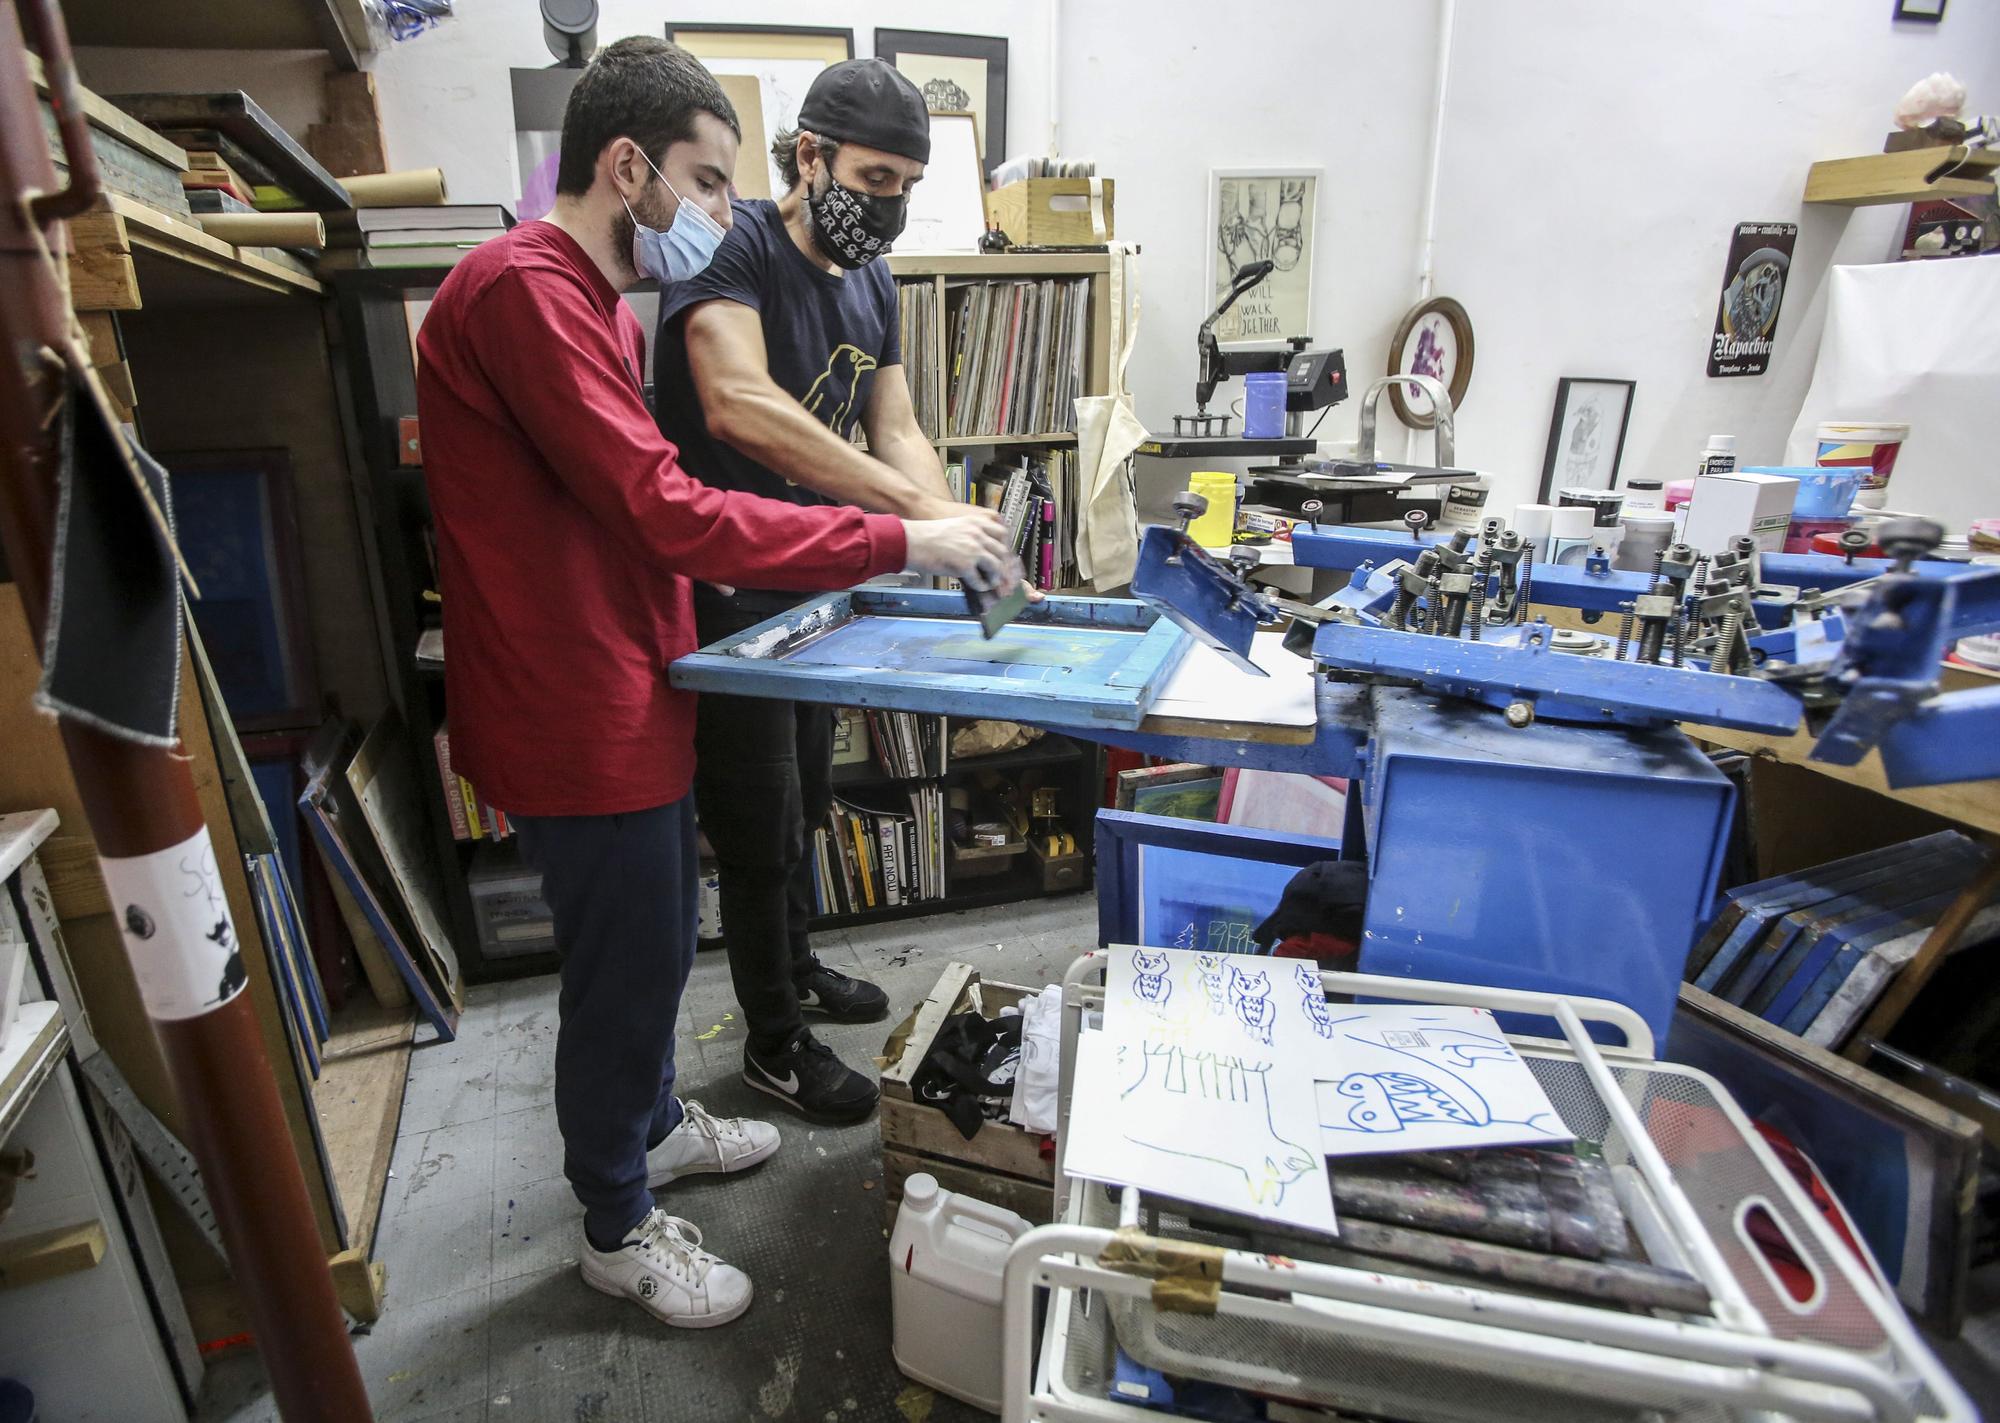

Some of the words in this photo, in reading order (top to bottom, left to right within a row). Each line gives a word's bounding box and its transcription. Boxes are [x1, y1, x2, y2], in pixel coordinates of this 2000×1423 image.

[1248, 285, 1274, 299] WILL
[1241, 303, 1272, 316] WALK
[440, 741, 457, 787] CHINESE
[449, 789, 466, 831] DESIGN
[883, 844, 893, 862] ART
[886, 866, 896, 892] NOW
